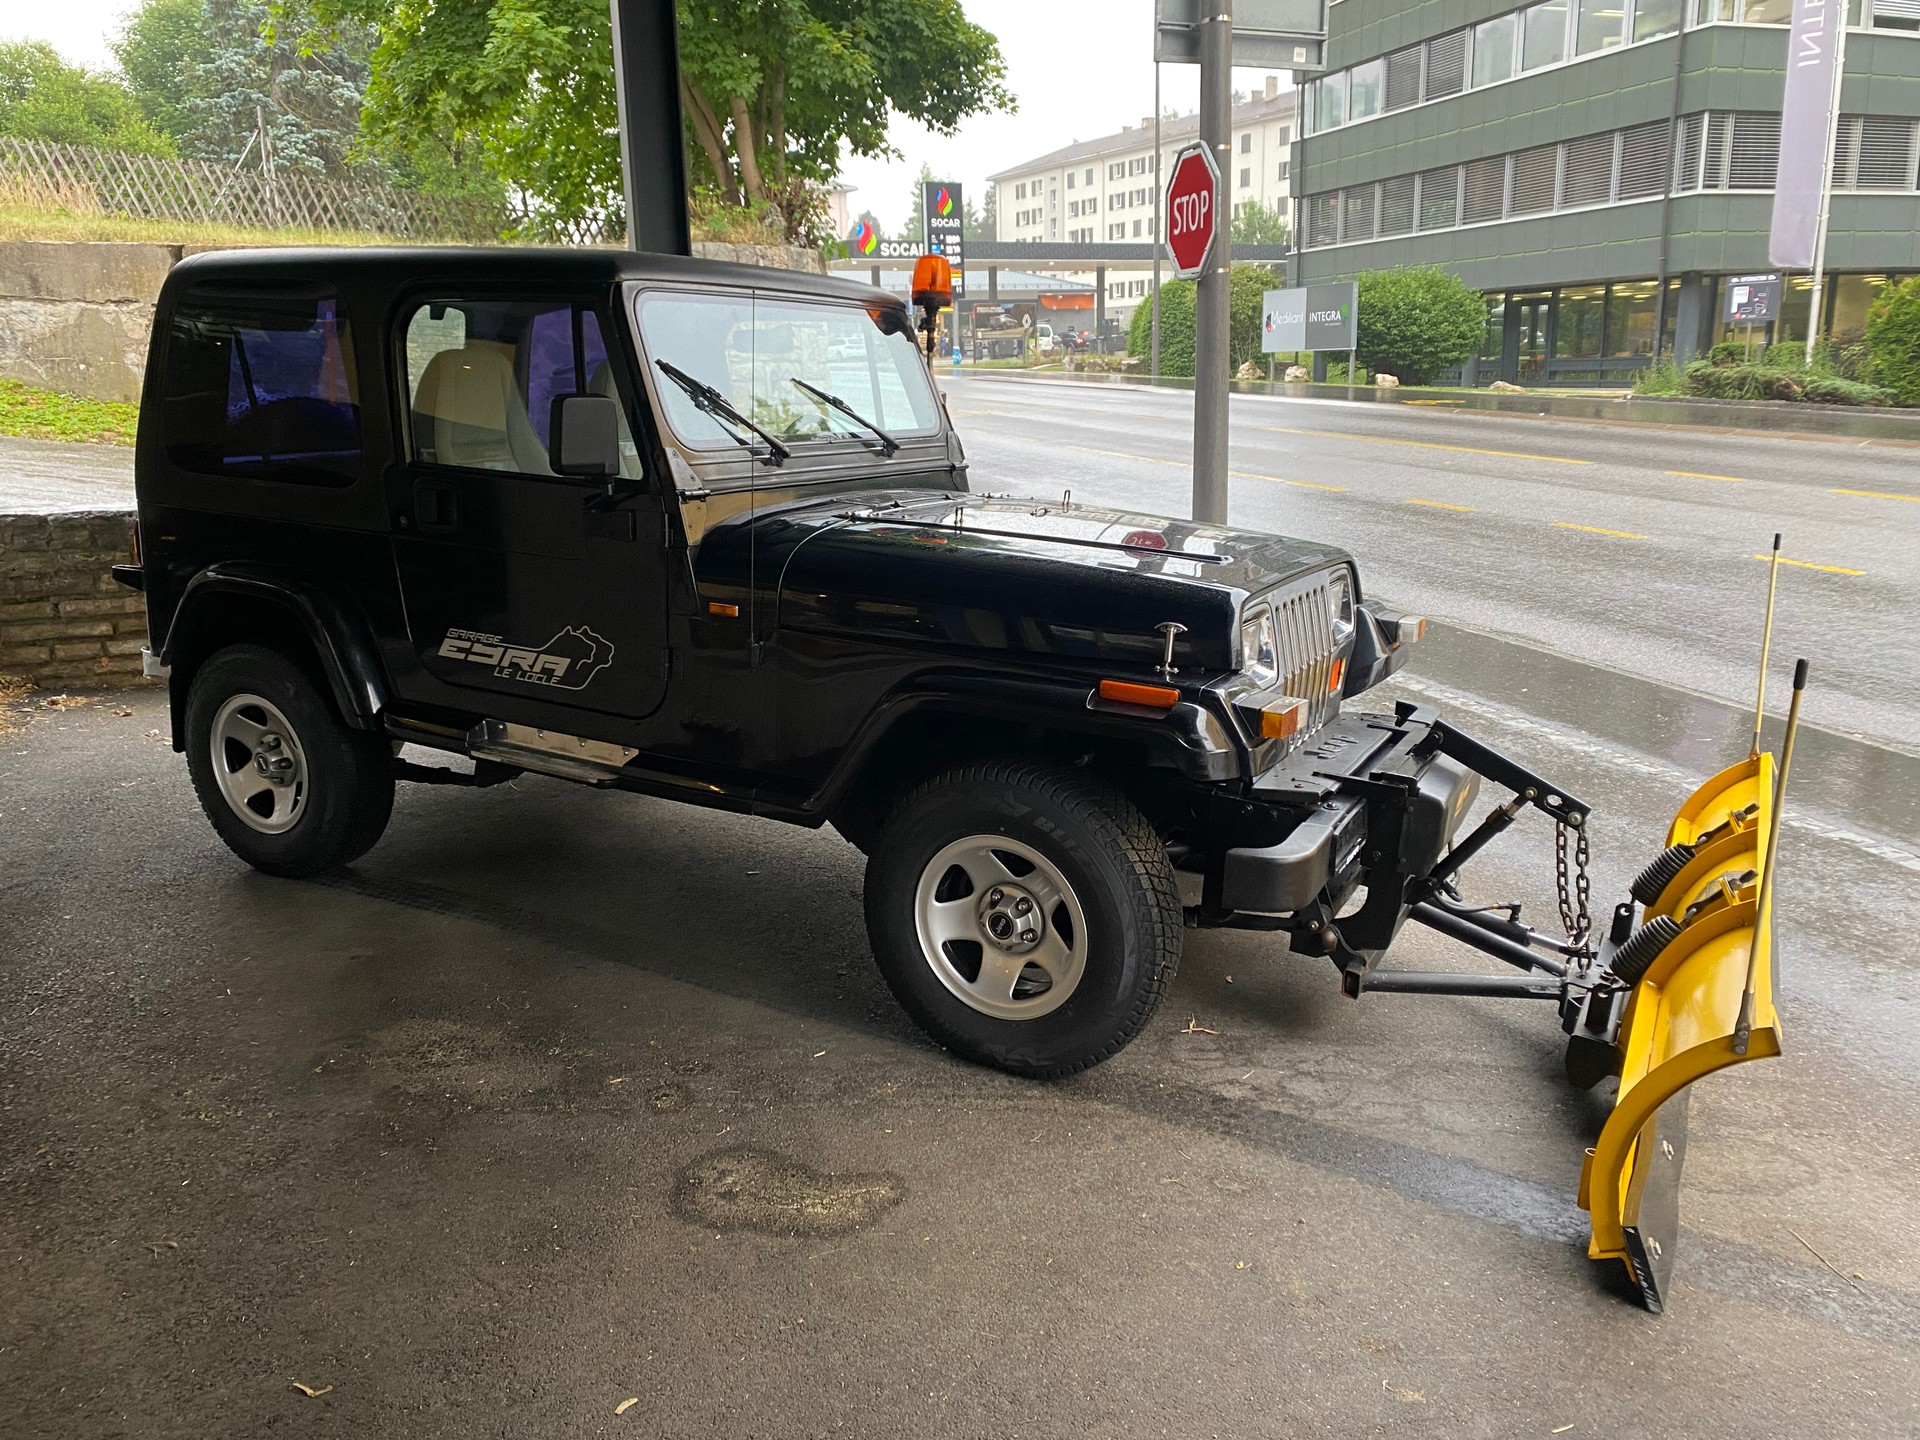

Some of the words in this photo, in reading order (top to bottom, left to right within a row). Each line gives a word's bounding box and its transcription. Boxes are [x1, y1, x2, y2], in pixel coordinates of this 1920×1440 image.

[1173, 190, 1209, 235] STOP
[931, 218, 960, 228] SOCAR
[1309, 310, 1342, 322] INTEGRA
[446, 627, 503, 644] GARAGE
[493, 666, 513, 679] LE
[515, 670, 561, 686] LOCLE
